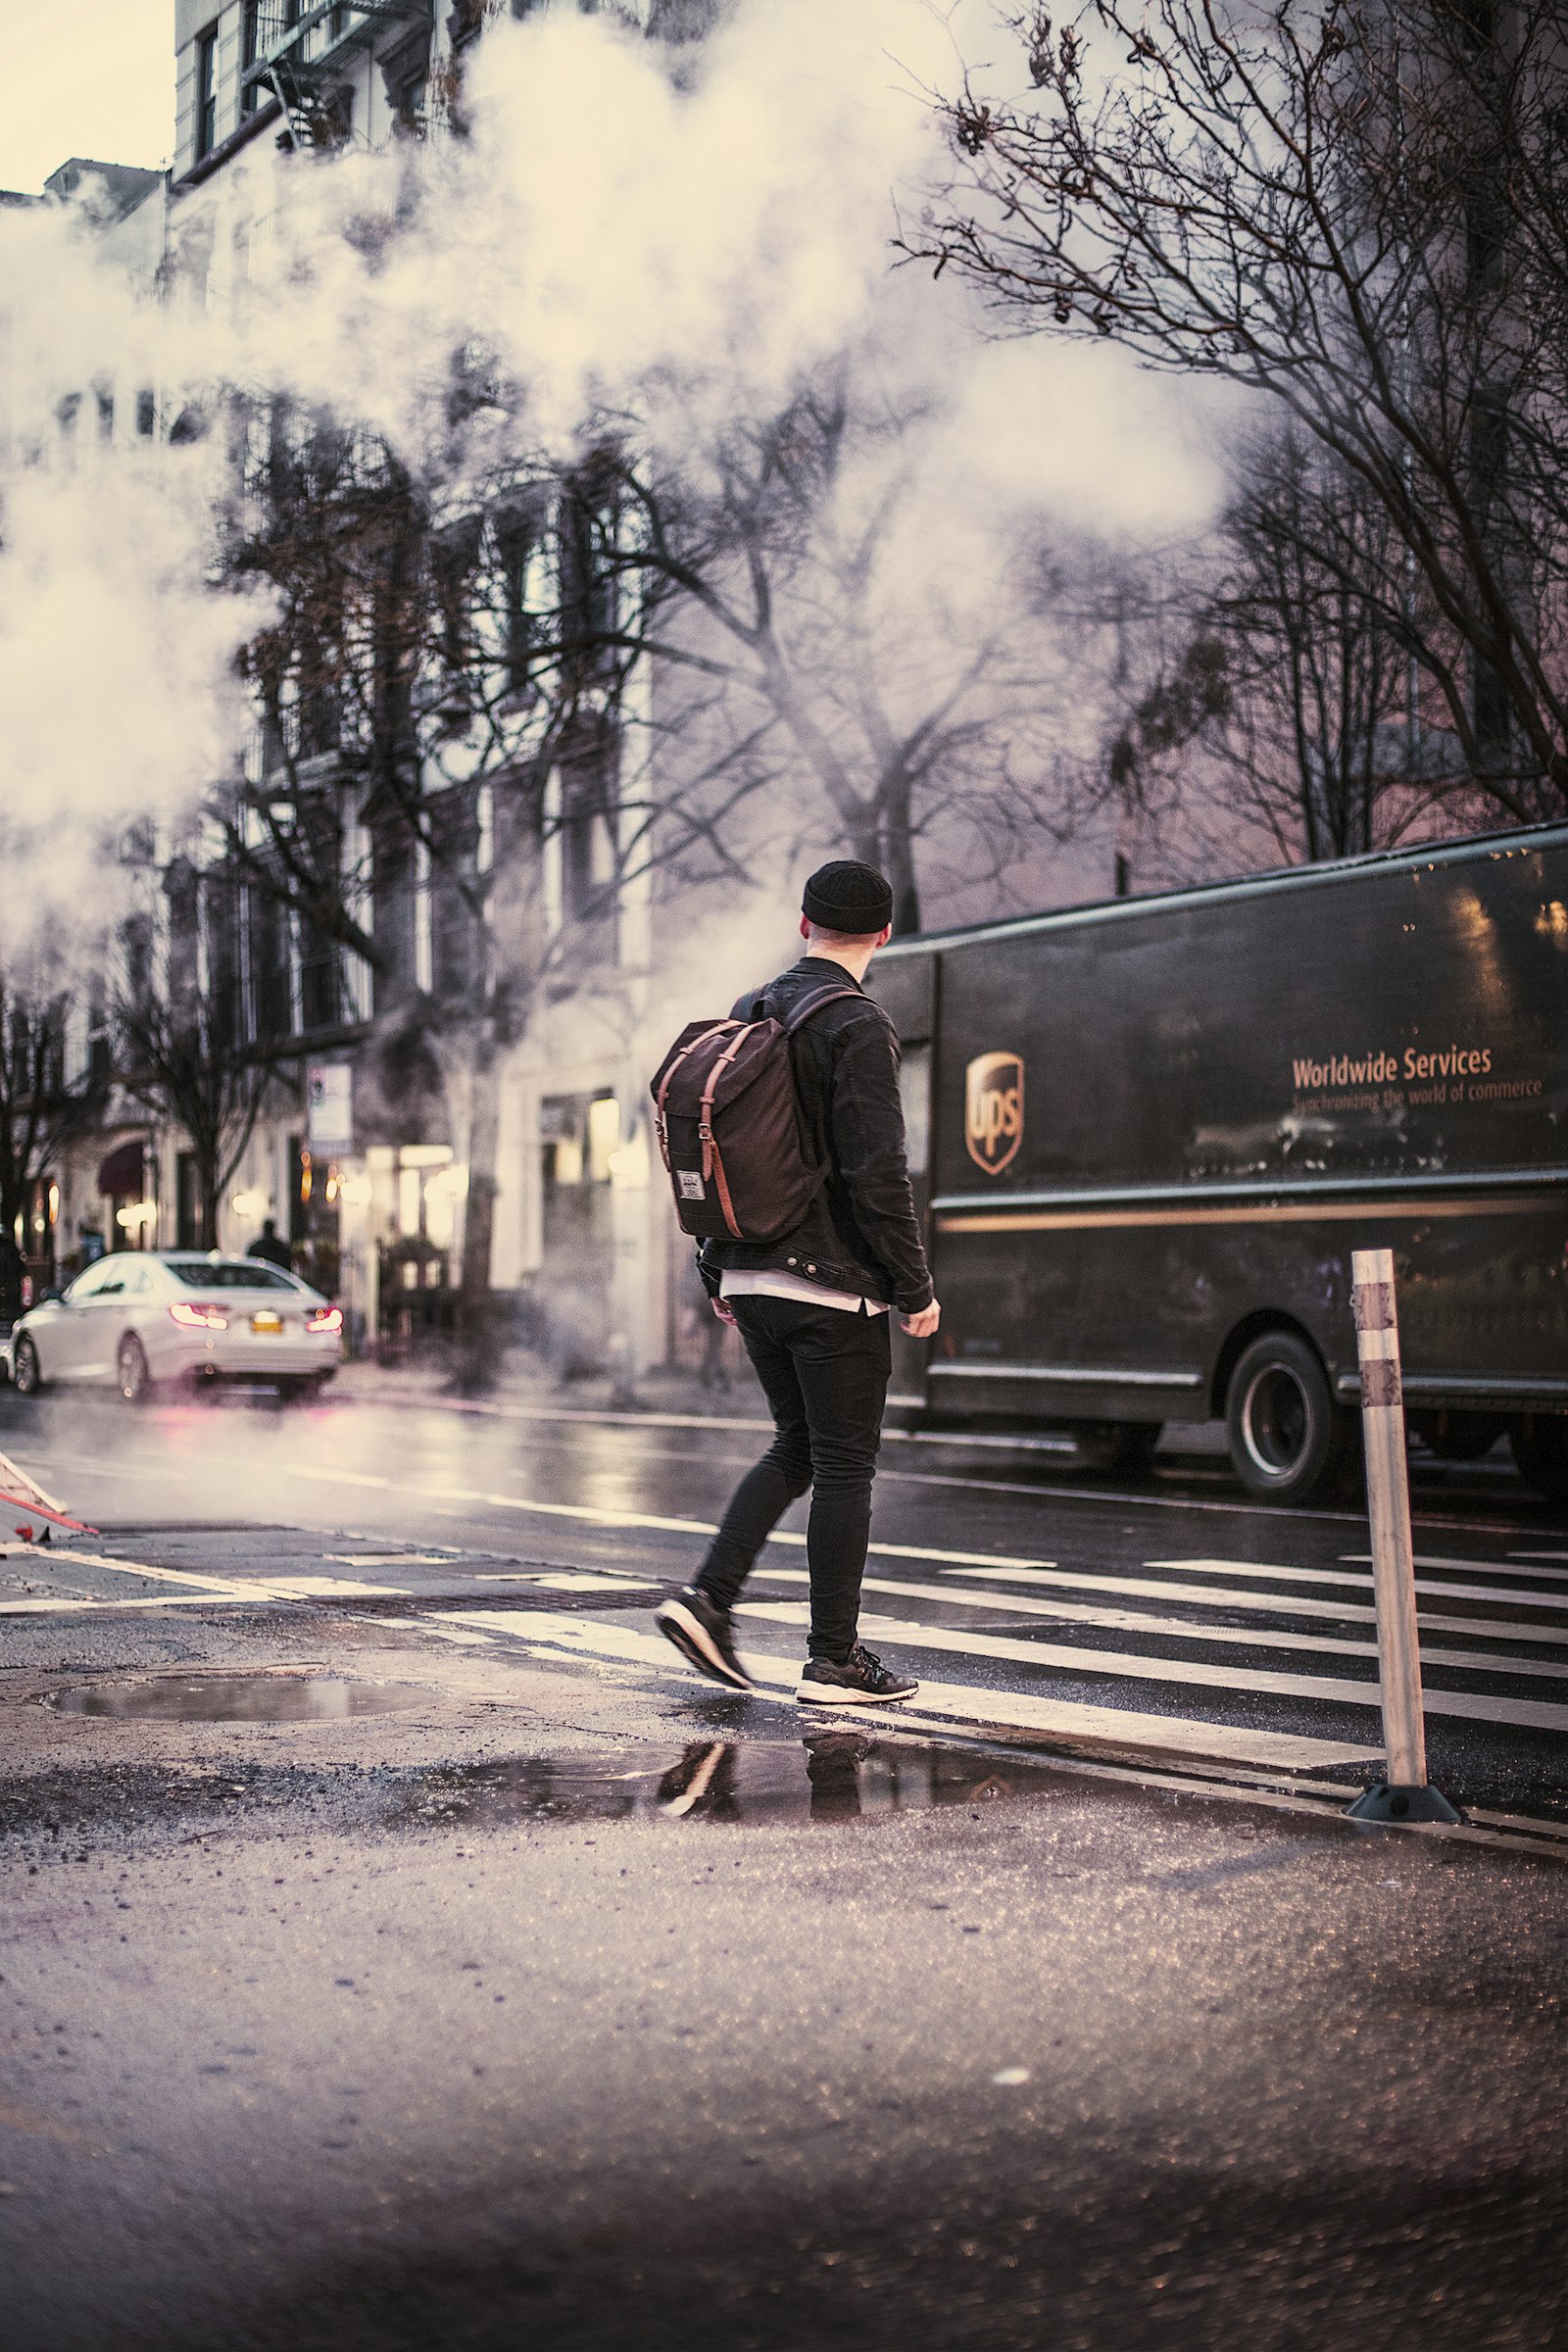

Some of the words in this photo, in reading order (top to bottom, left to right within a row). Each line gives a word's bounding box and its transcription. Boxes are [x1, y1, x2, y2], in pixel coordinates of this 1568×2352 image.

[1293, 1051, 1398, 1089] Worldwide
[1403, 1043, 1492, 1080] Services
[1383, 1088, 1404, 1109] the
[1408, 1082, 1446, 1104] world
[1450, 1081, 1464, 1102] of
[1469, 1079, 1543, 1101] commerce
